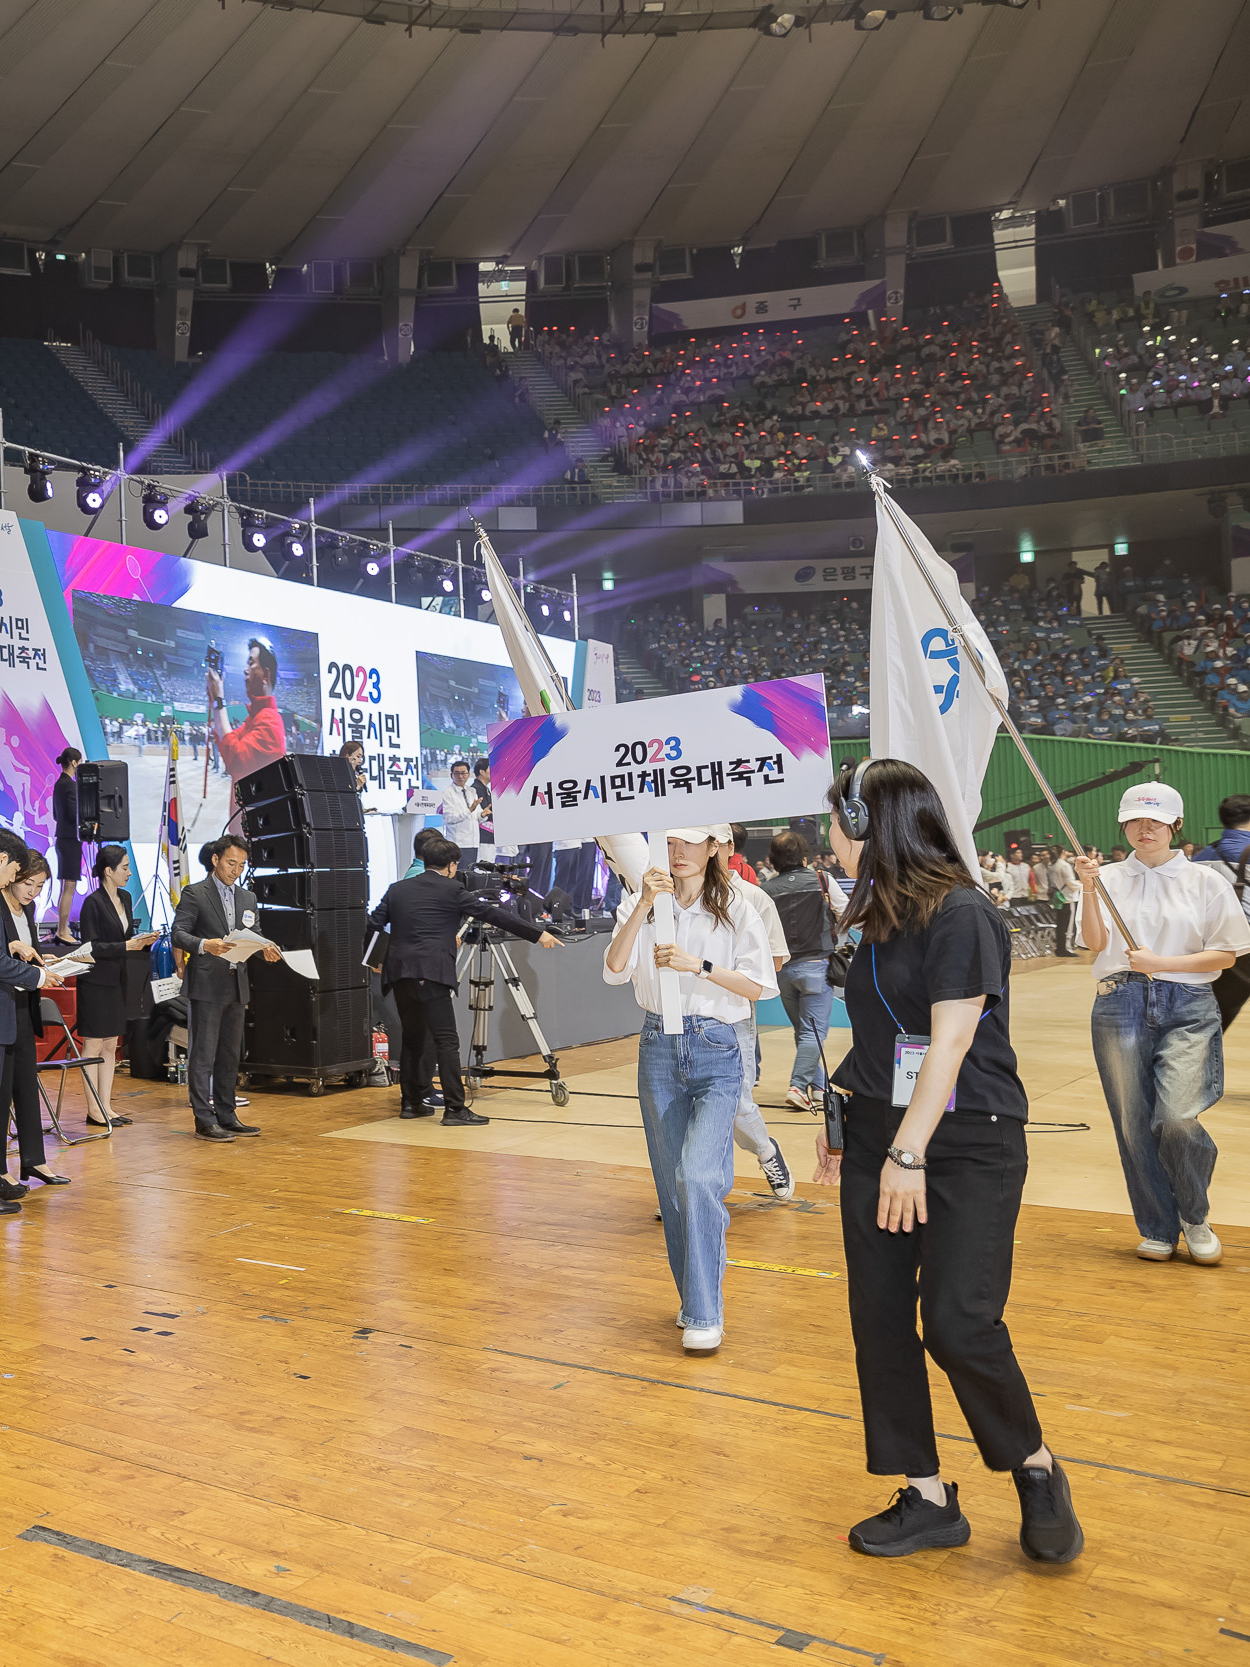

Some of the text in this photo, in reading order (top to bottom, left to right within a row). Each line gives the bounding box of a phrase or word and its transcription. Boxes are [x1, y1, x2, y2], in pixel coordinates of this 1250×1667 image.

[400, 325, 411, 335] 20
[822, 565, 874, 582] 은평구
[327, 661, 382, 704] 2023
[587, 688, 602, 703] 2023
[328, 707, 401, 749] 서울시민
[614, 736, 683, 768] 2023
[530, 752, 785, 810] 서울시민체육대축전
[905, 1071, 920, 1080] ST
